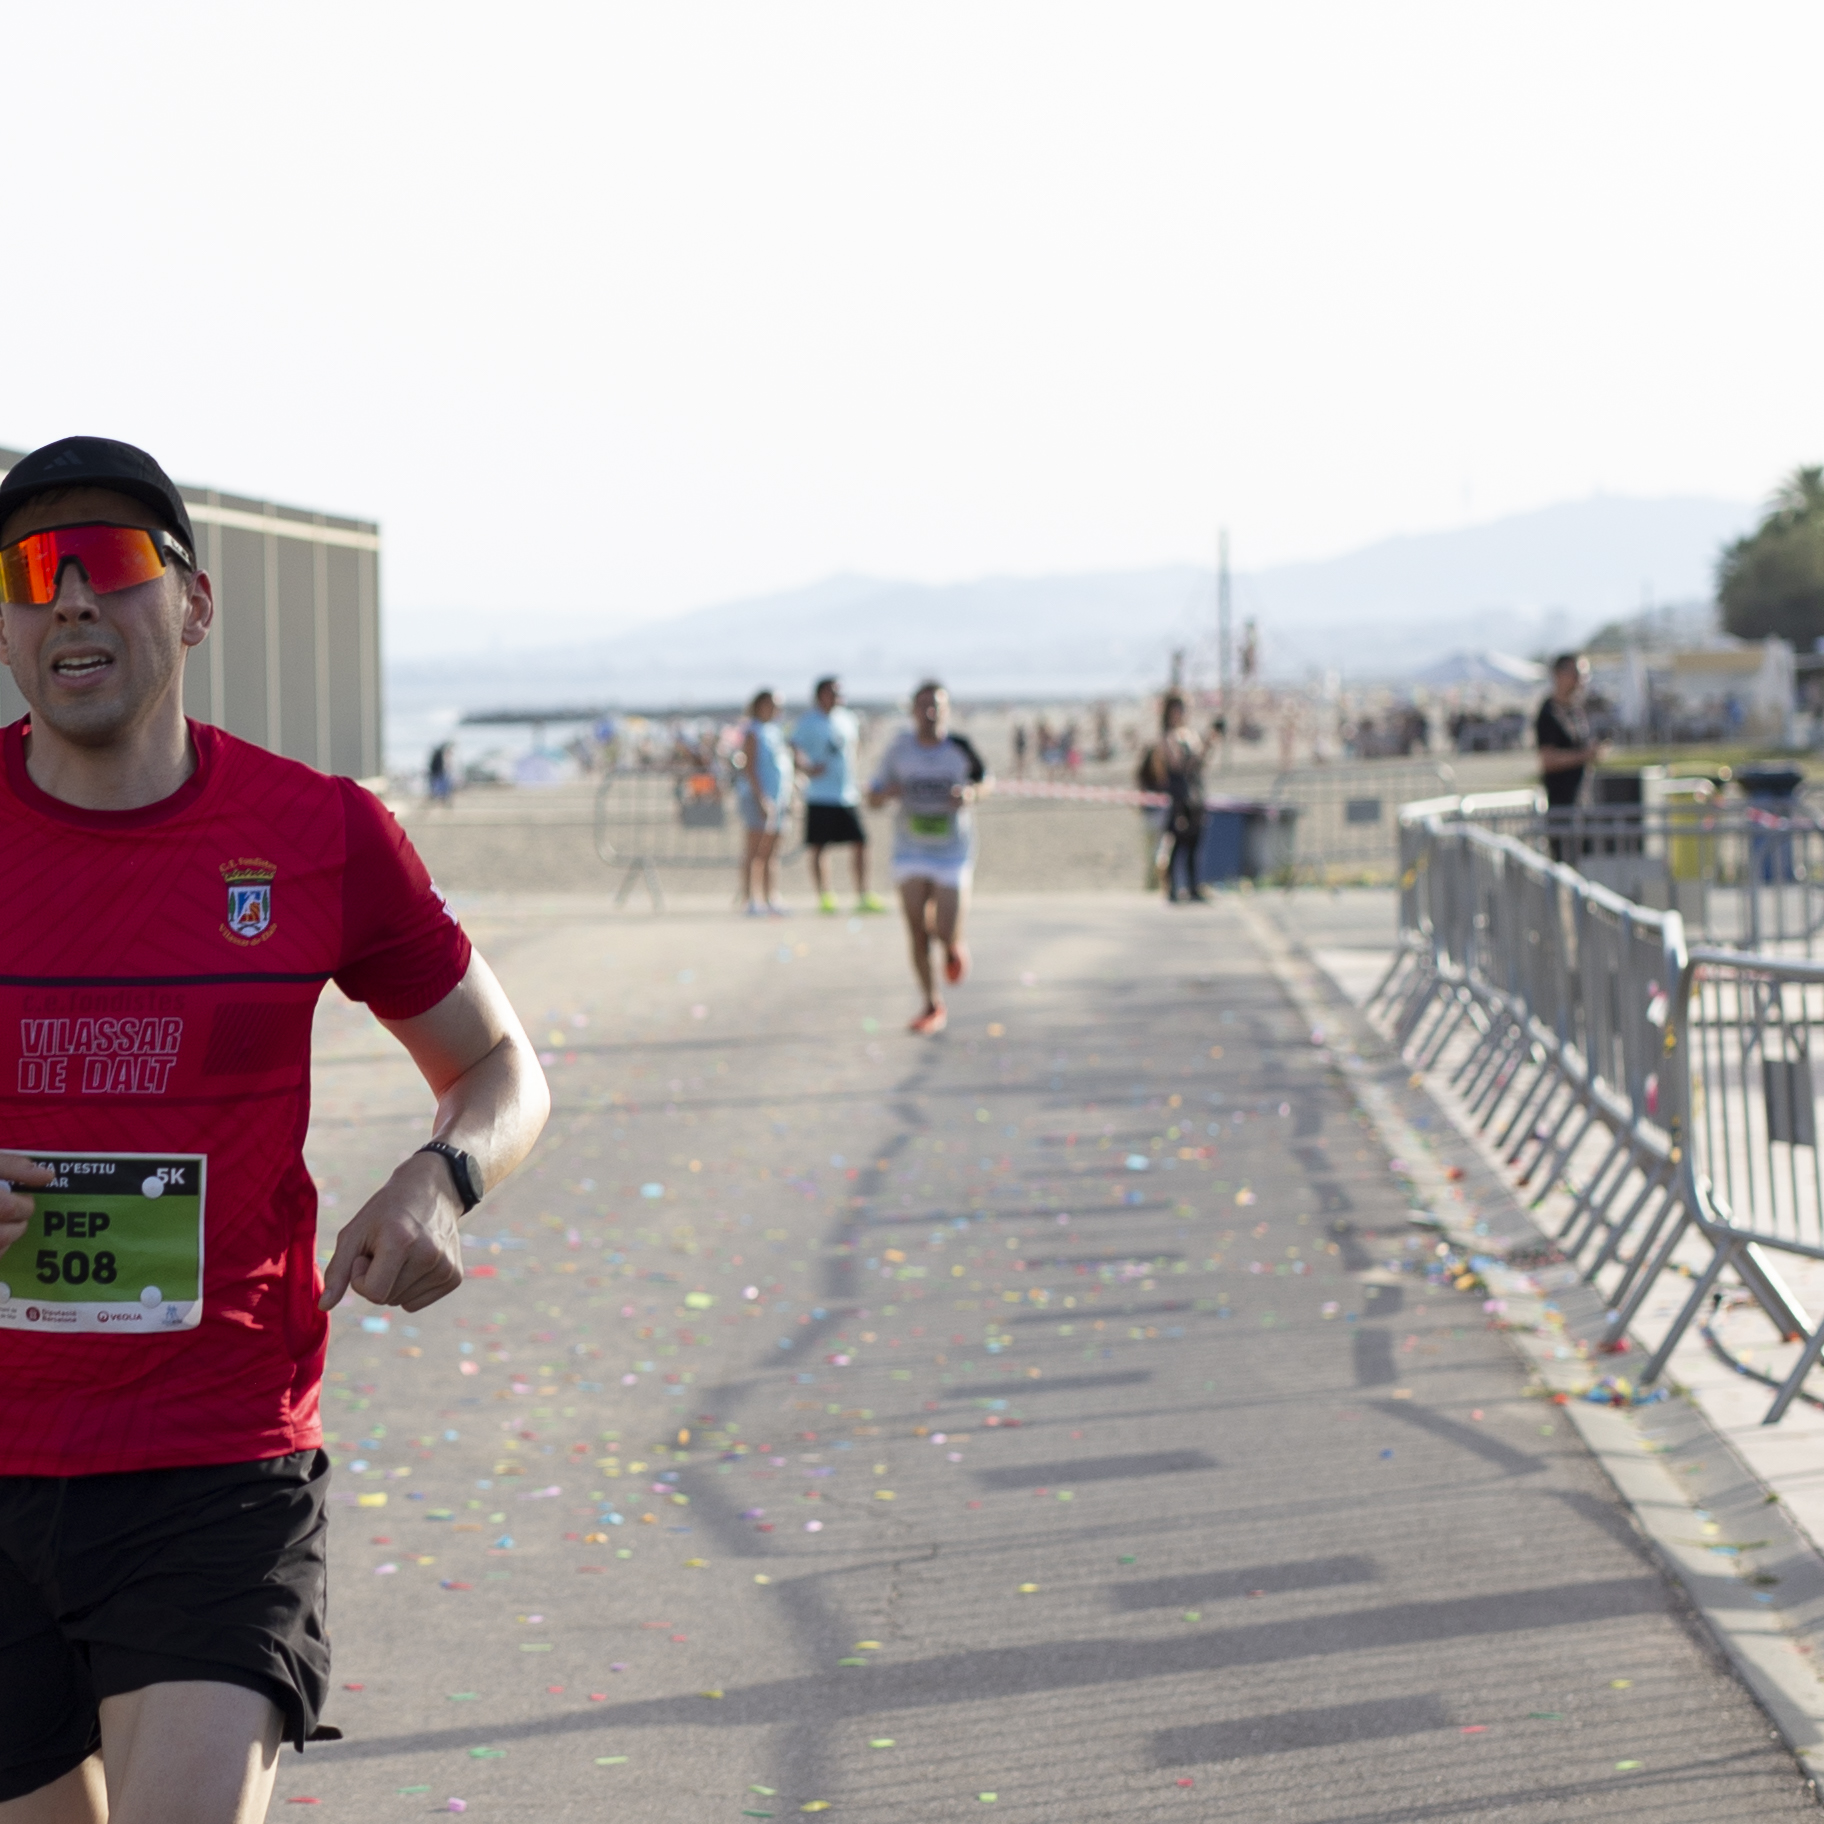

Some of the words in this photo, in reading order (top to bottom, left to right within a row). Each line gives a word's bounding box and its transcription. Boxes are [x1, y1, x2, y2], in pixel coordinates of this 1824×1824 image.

[20, 1017, 184, 1057] VILASSAR
[17, 1057, 68, 1094] DE
[81, 1056, 177, 1094] DALT
[60, 1162, 116, 1175] D'ESTIU
[156, 1167, 185, 1185] 5K
[43, 1210, 111, 1239] PEP
[35, 1250, 118, 1285] 508
